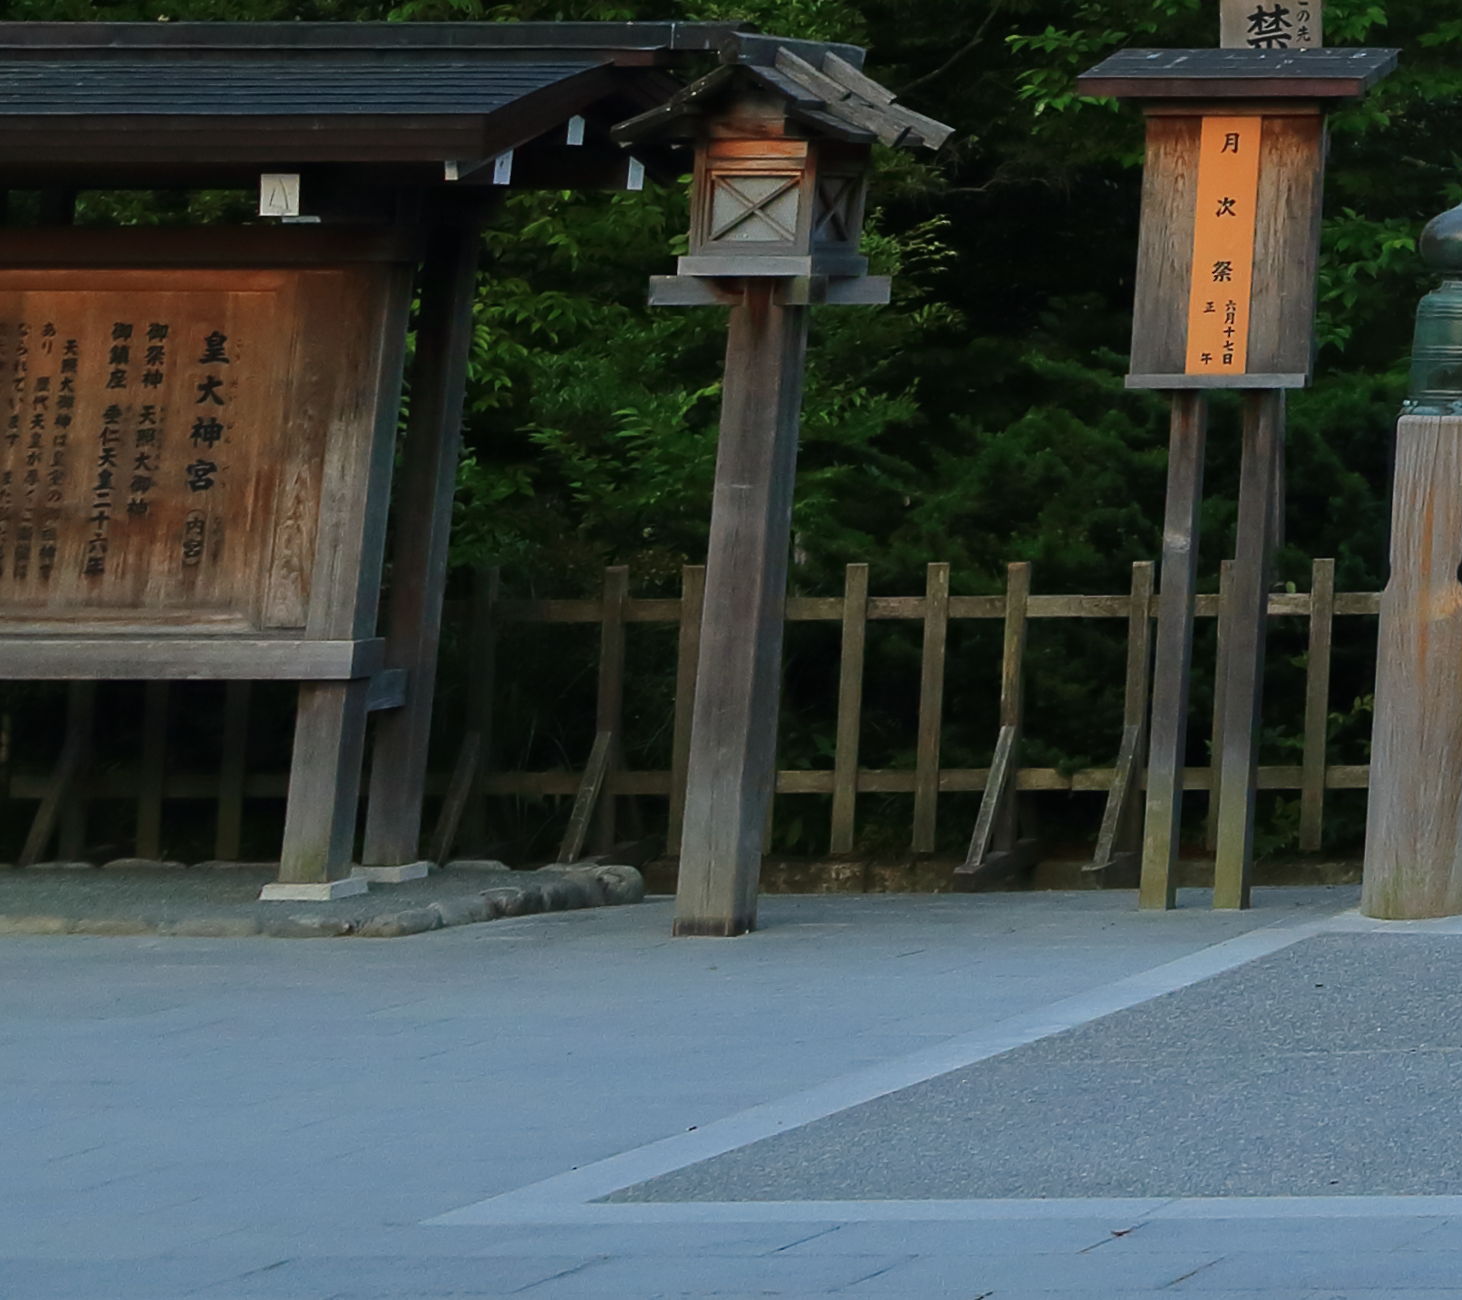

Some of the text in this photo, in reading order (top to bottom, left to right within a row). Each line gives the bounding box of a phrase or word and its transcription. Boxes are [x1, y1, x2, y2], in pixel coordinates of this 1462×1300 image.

[1211, 132, 1241, 283] 月次祭
[1222, 300, 1236, 366] 六月十七日
